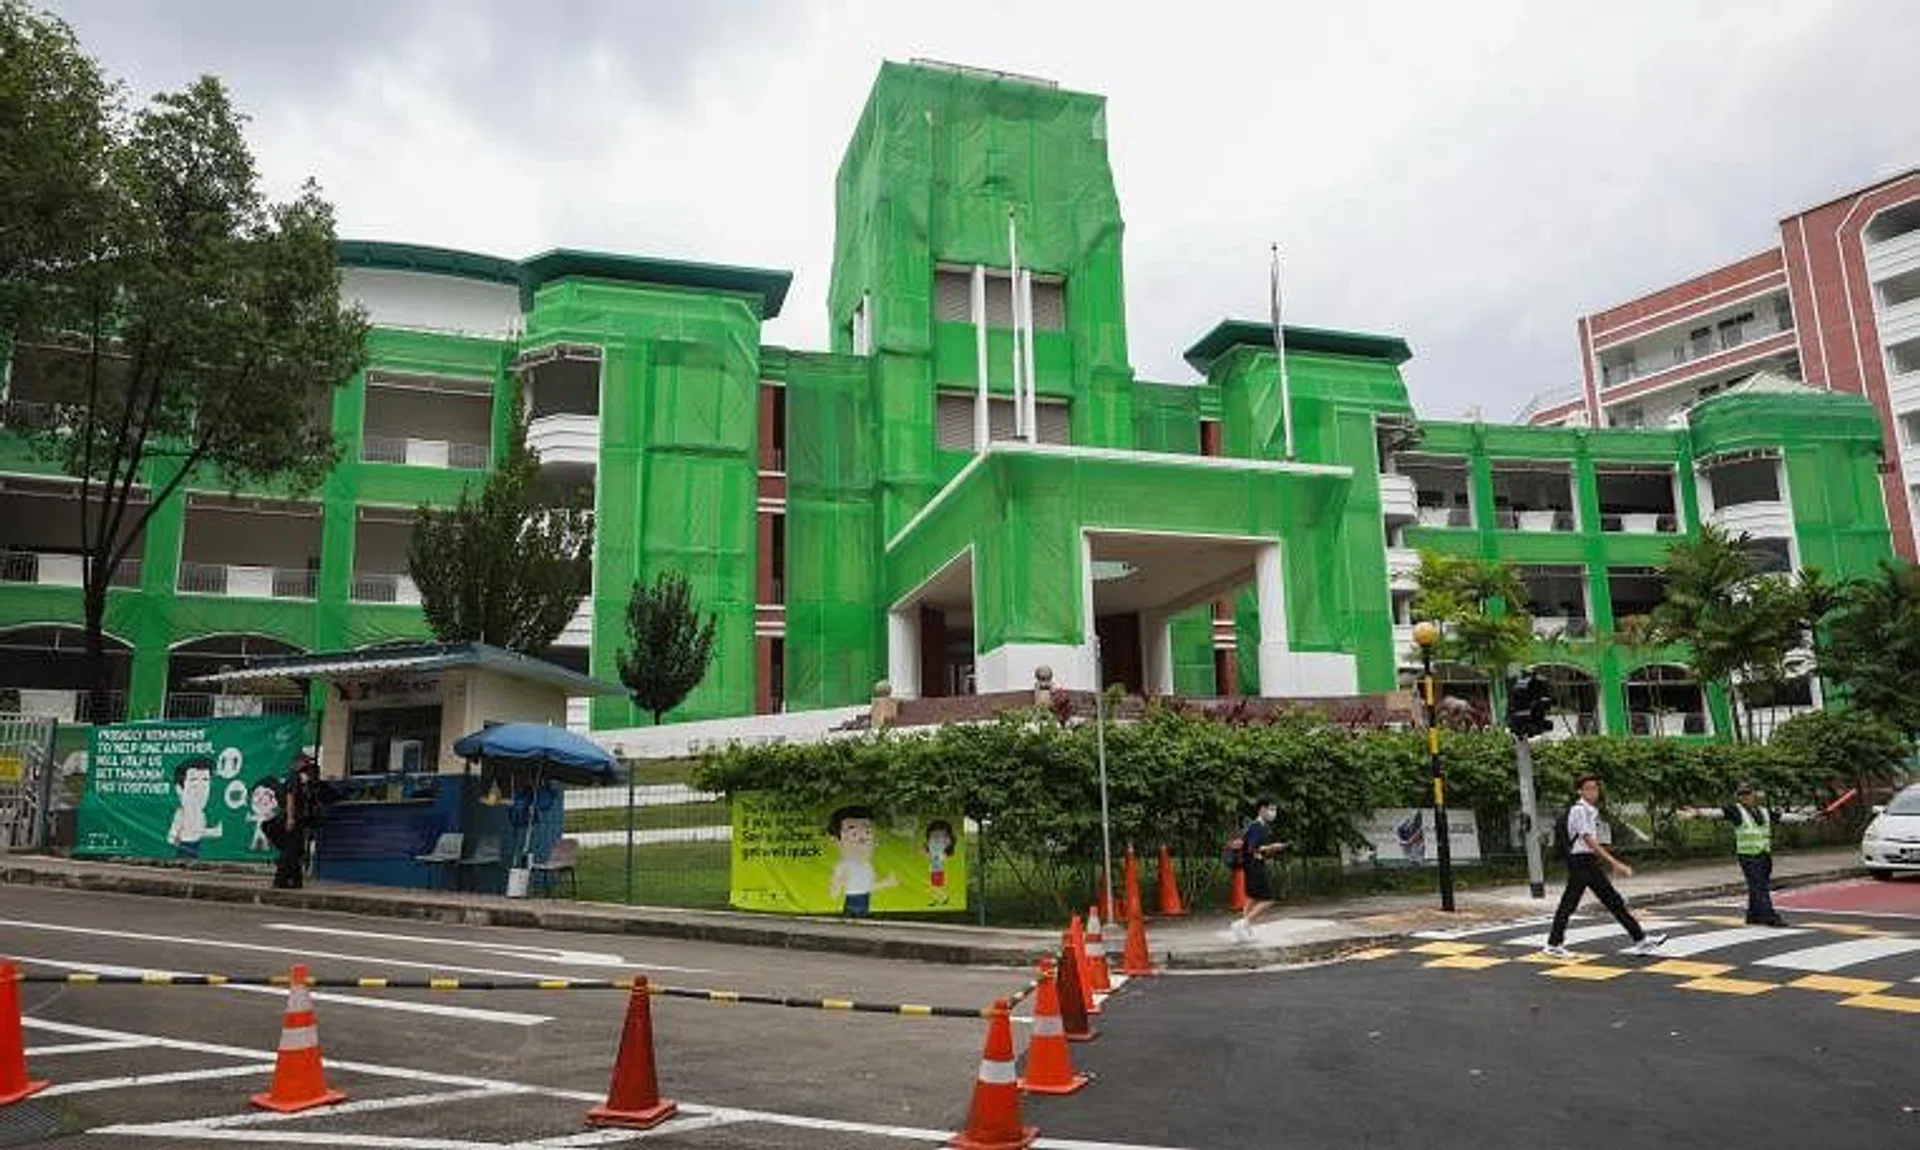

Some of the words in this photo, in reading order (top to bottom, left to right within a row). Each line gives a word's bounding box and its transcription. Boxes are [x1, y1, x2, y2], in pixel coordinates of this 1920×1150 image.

[97, 742, 111, 753] TO
[113, 742, 139, 753] HELP
[140, 742, 162, 754] ONE
[120, 755, 147, 766] HELP
[148, 755, 162, 766] US
